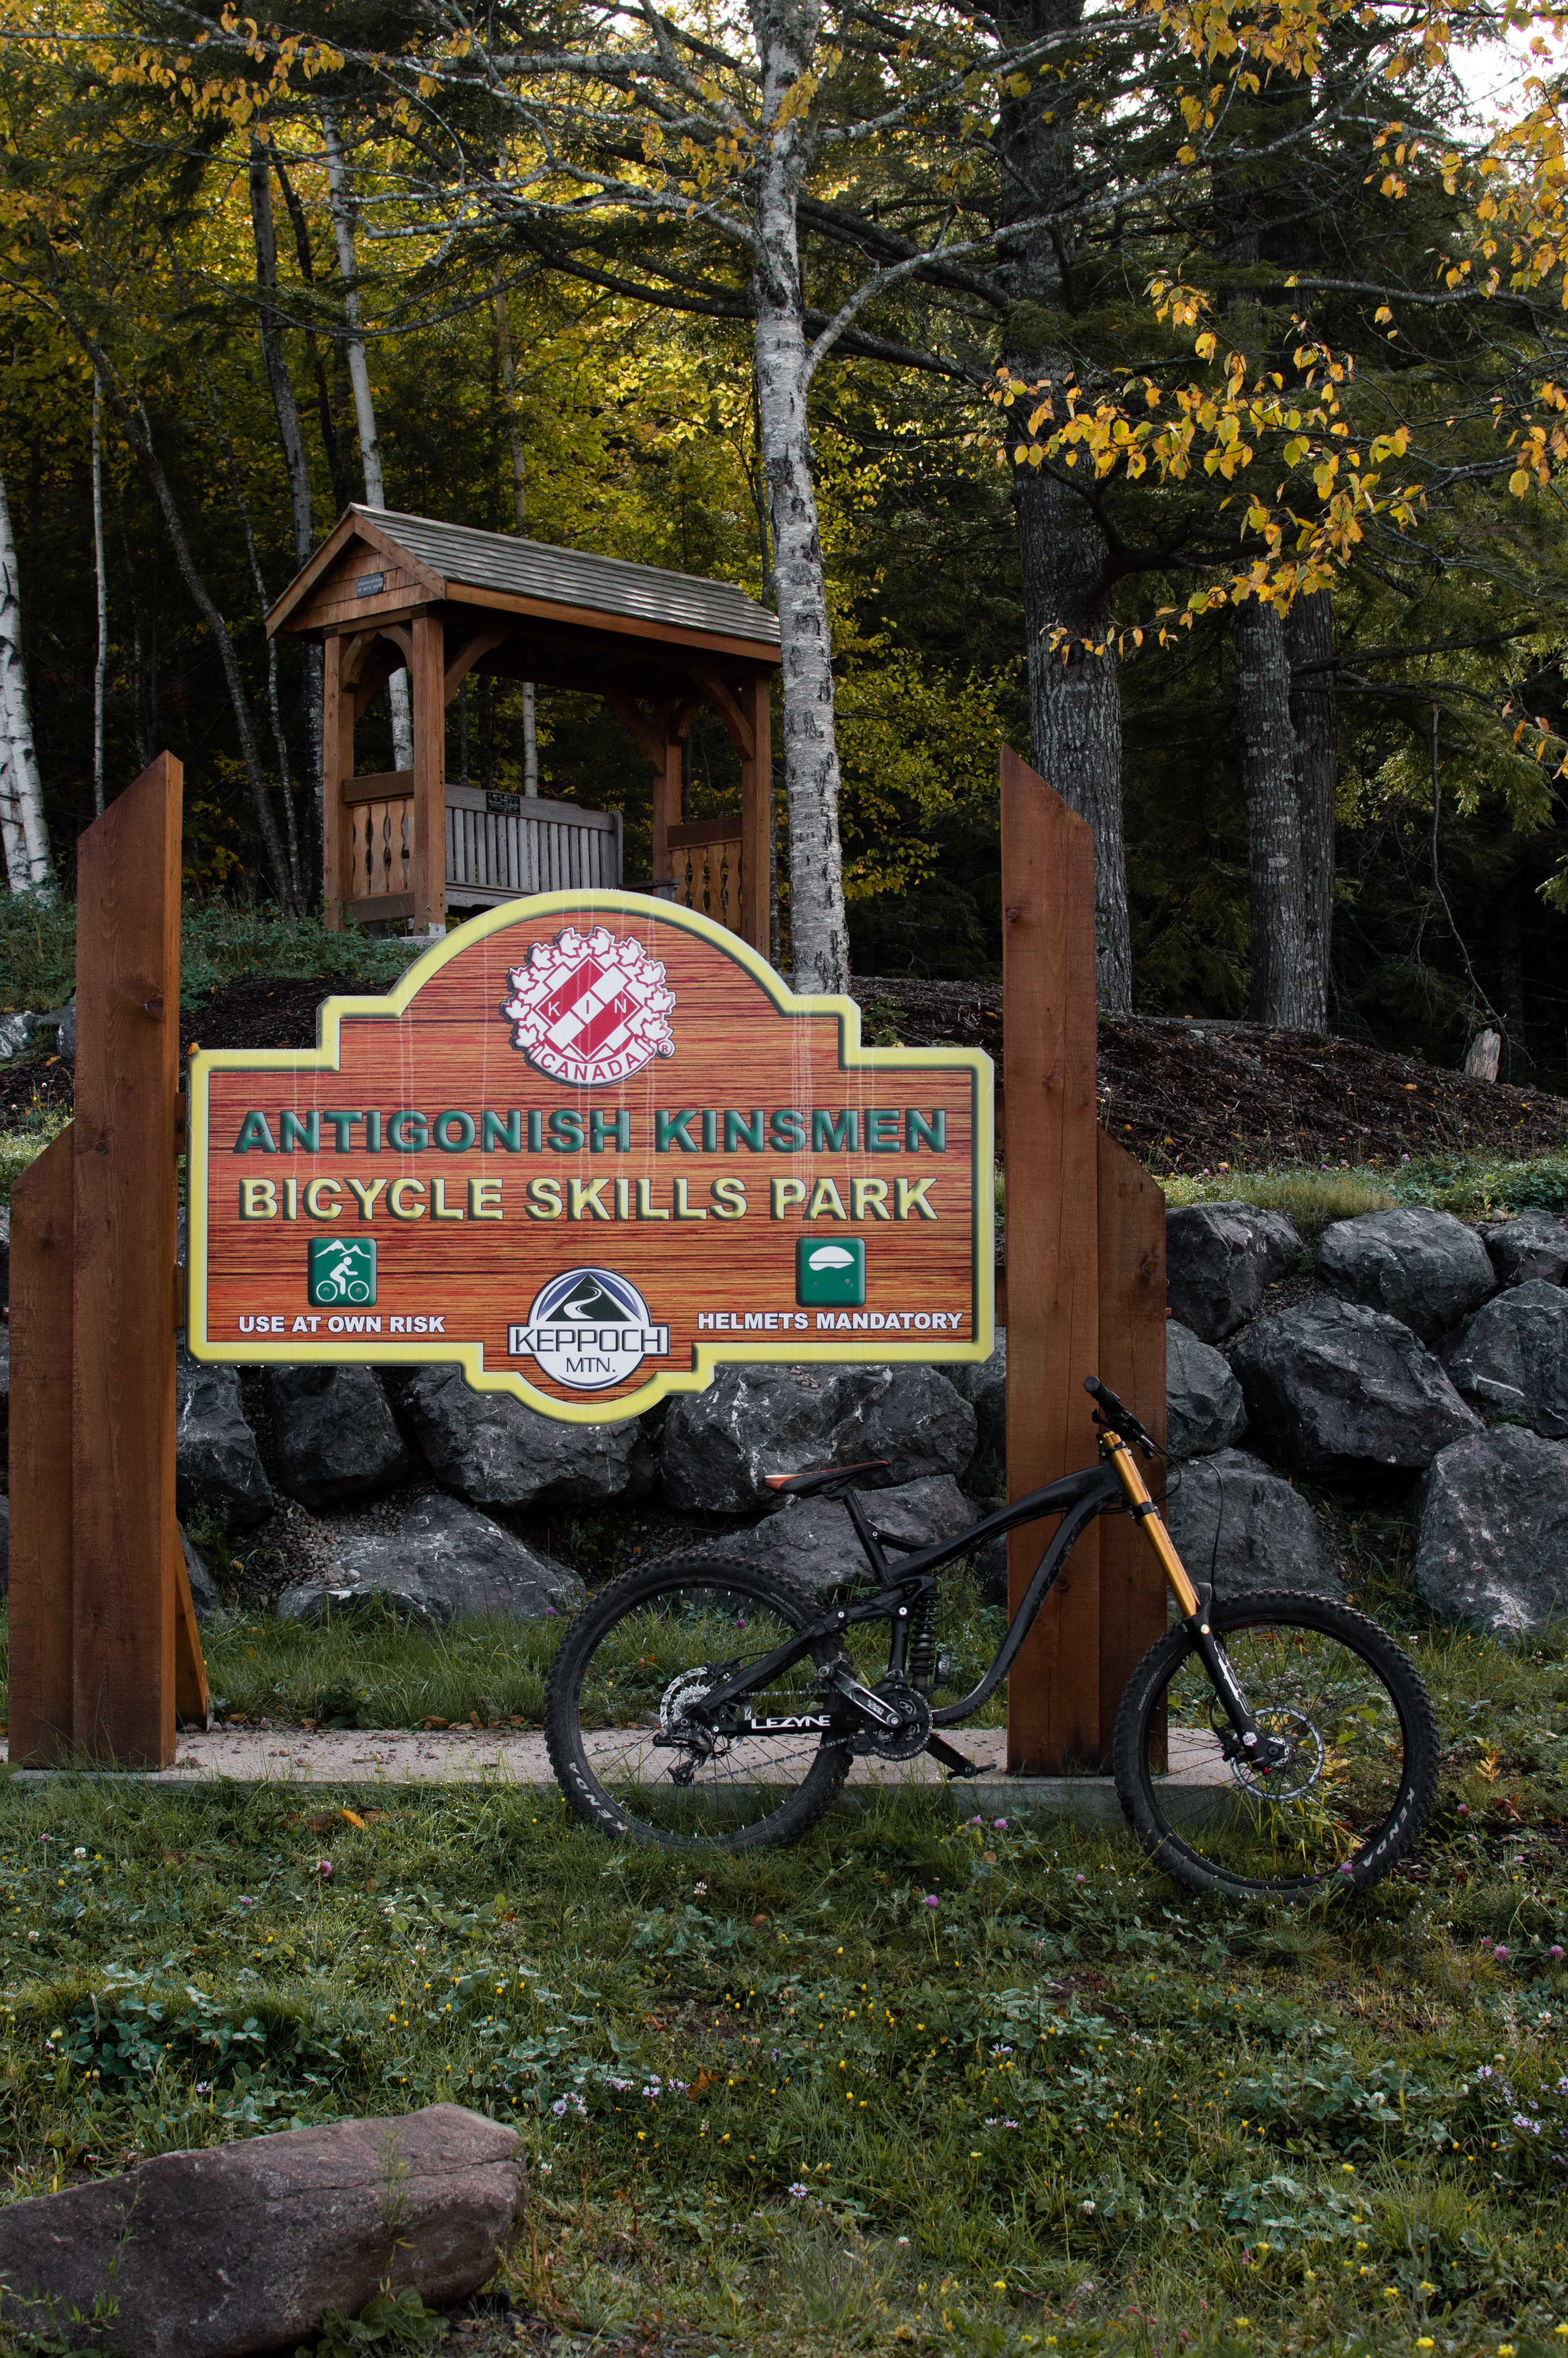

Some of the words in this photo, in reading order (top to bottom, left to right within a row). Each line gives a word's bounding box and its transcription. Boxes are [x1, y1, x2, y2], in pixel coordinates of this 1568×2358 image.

[548, 999, 627, 1017] KIN
[541, 1052, 641, 1081] CANADA
[233, 1110, 630, 1153] ANTIGONISH
[655, 1109, 946, 1153] KINSMEN
[239, 1178, 503, 1221] BICYCLE
[525, 1178, 747, 1221] SKILLS
[770, 1178, 939, 1221] PARK
[238, 1315, 285, 1333] USE
[291, 1316, 321, 1333] AT
[327, 1315, 382, 1333] OWN
[389, 1316, 446, 1333] RISK
[698, 1312, 809, 1330] HELMETS
[816, 1312, 963, 1330] MANDATORY
[515, 1329, 662, 1352] KEPPOCH
[566, 1357, 616, 1373] MTN.
[769, 1592, 785, 1603] KENDA
[868, 1702, 883, 1715] RACE
[1138, 1693, 1147, 1711] KENDA
[751, 1715, 831, 1729] LEZYNE
[568, 1762, 629, 1831] KENDA
[1363, 1786, 1415, 1868] KENDA
